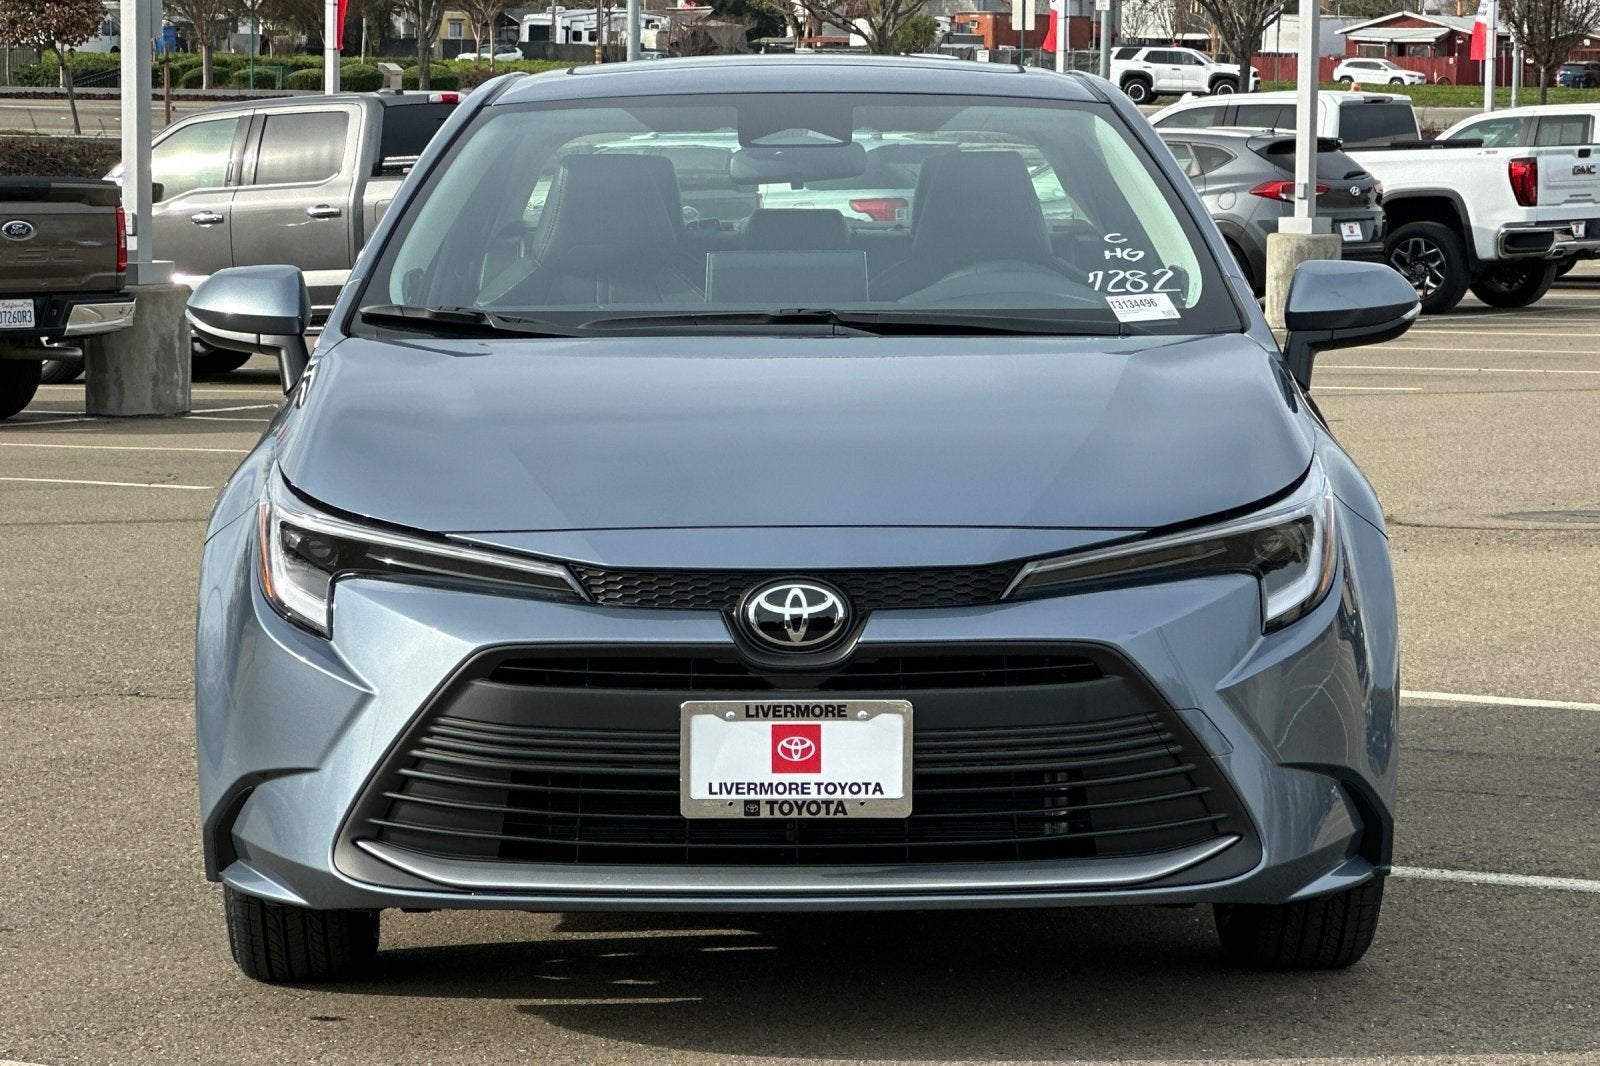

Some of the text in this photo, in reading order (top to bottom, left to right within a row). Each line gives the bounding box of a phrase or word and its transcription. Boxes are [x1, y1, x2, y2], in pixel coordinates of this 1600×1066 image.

[1572, 165, 1597, 175] GMC
[10, 224, 27, 235] Ford
[1088, 268, 1181, 293] 7282
[1110, 298, 1158, 310] T3134496
[745, 704, 847, 718] LIVERMORE
[708, 782, 884, 796] LIVERMORE TOYOTA
[766, 800, 848, 816] TOYOTA
